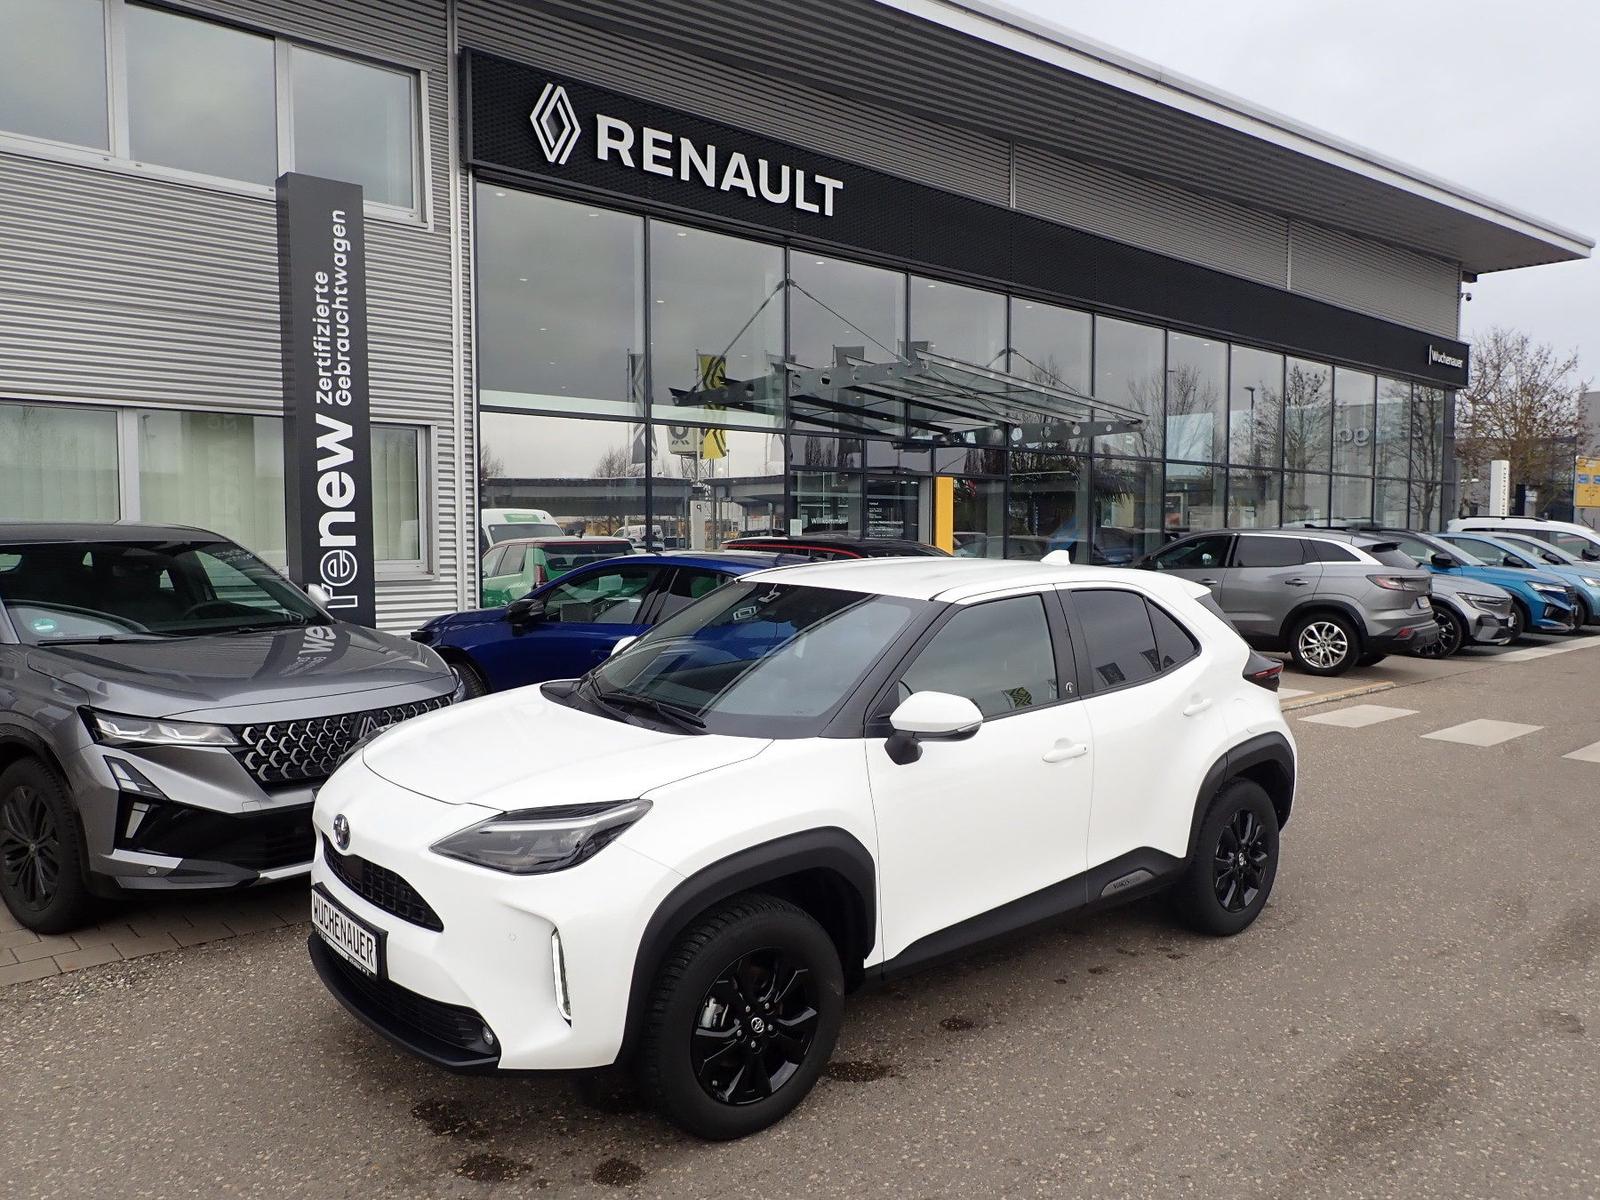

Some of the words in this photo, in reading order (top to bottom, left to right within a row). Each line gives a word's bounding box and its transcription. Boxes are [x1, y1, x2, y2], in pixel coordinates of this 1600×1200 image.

[596, 113, 844, 217] RENAULT
[312, 271, 333, 405] Zertifizierte
[331, 209, 352, 406] Gebrauchtwagen
[315, 413, 358, 609] renew
[312, 893, 375, 967] WUCHENAUER
